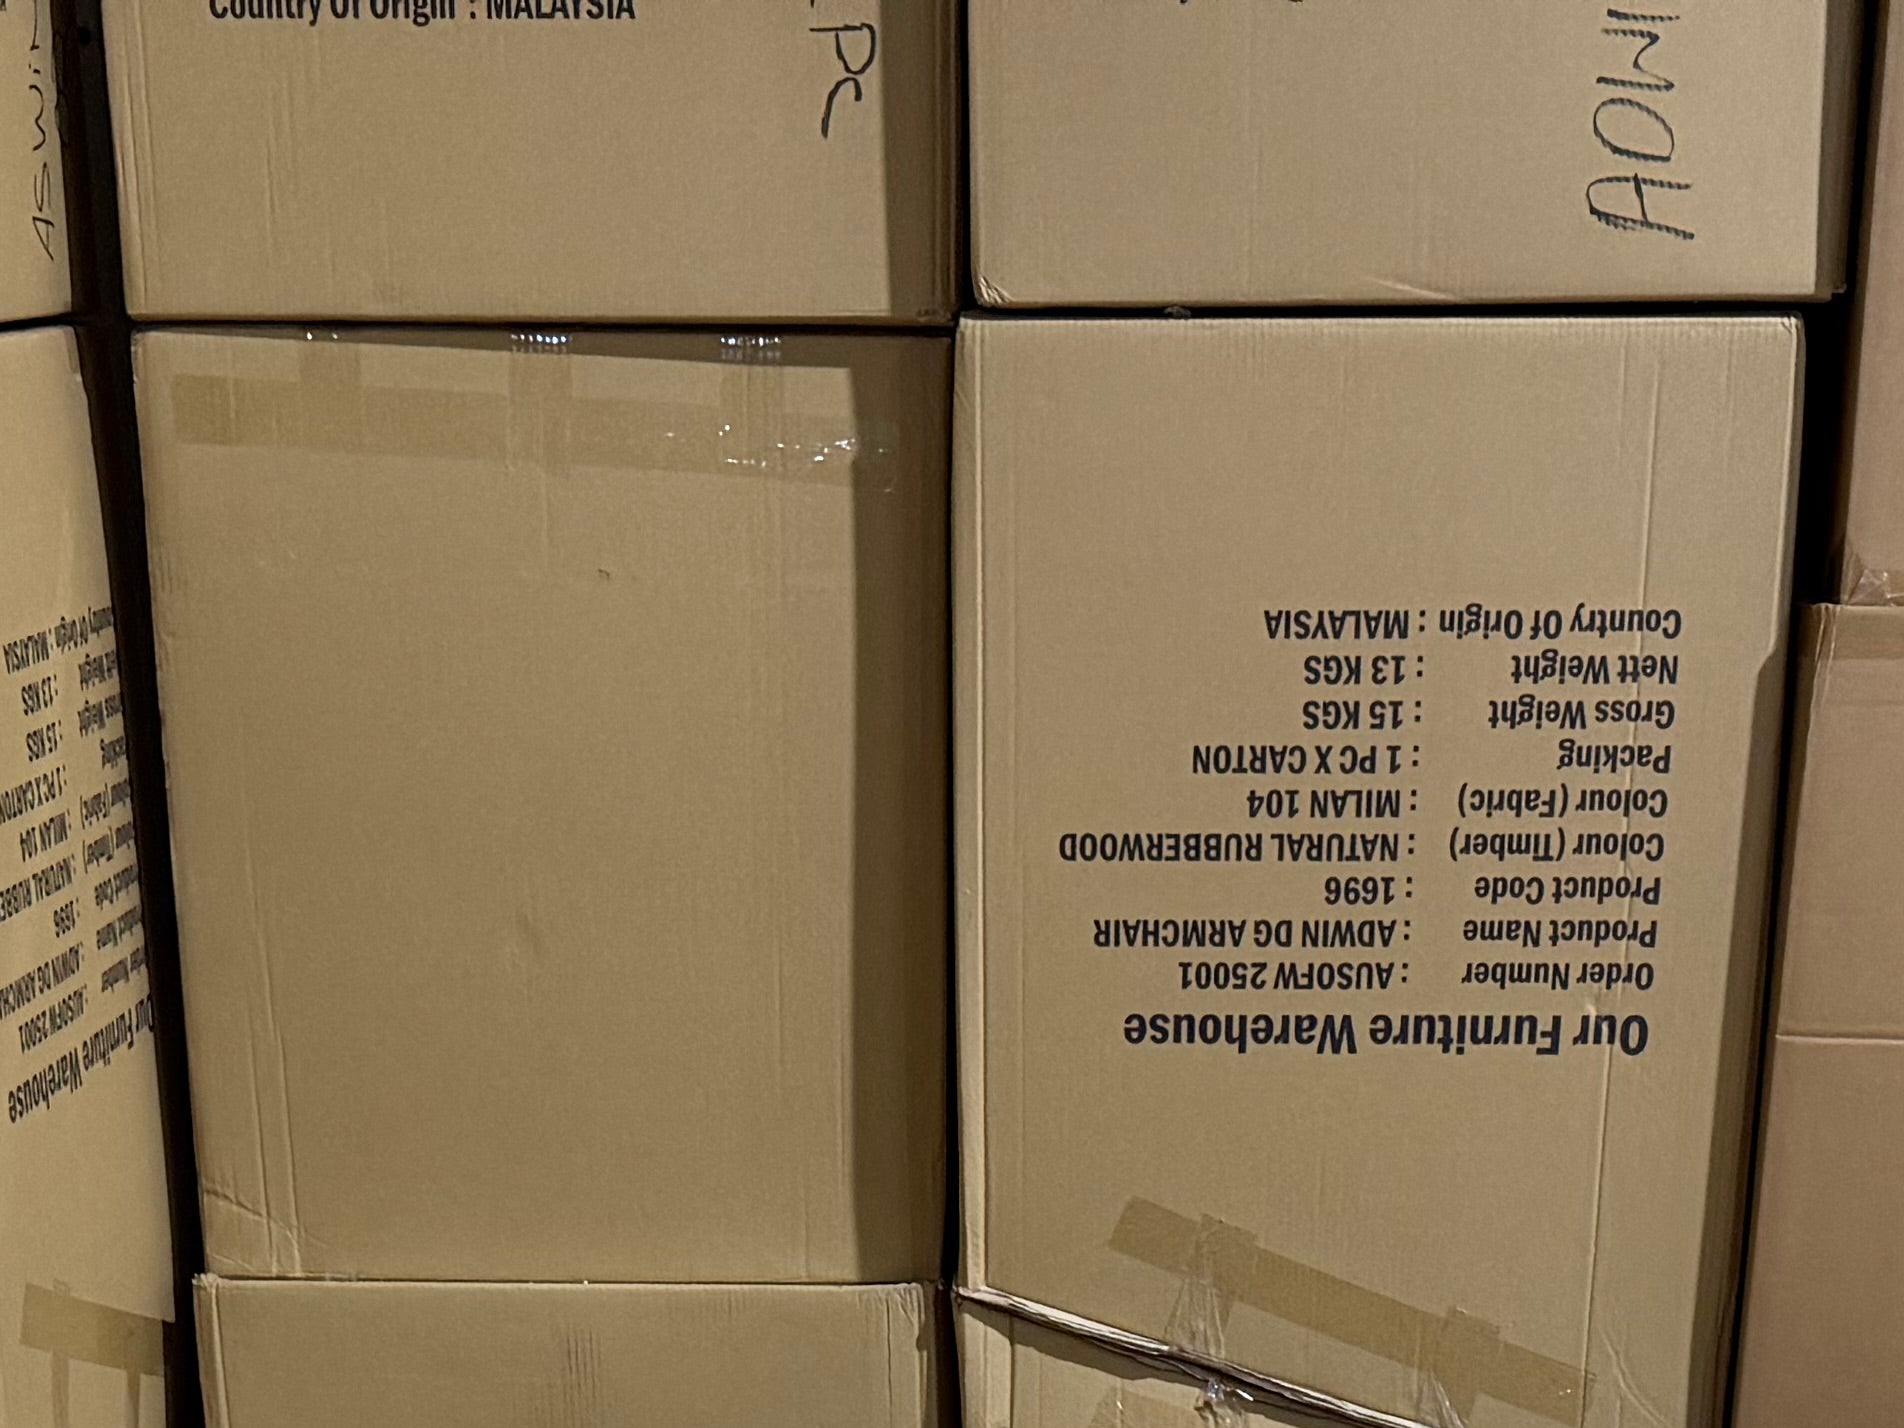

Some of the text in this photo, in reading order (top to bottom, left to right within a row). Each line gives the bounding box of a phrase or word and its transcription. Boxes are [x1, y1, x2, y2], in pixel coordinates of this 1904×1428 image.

[1264, 603, 1681, 640] Country Of Origin MALAYSIA
[1305, 649, 1678, 685] Nett Weight 13 KGS
[1303, 694, 1674, 729] Gross Weight 15 KGS
[1193, 739, 1671, 774] Packing 1 PC X CARTON
[1247, 783, 1667, 818] Colour (Fabric) MILAN 104
[1060, 827, 1664, 861] Colour (Timber) NATURAL RUBBERWOOD
[1325, 877, 1660, 905] Product Code 1696
[1094, 920, 1657, 947] Product Name ADWIN DG ARMCHAIR
[1179, 962, 1653, 990] Order Number AUSOFW 25001
[1124, 1014, 1648, 1055] Our Furniture Warehouse
